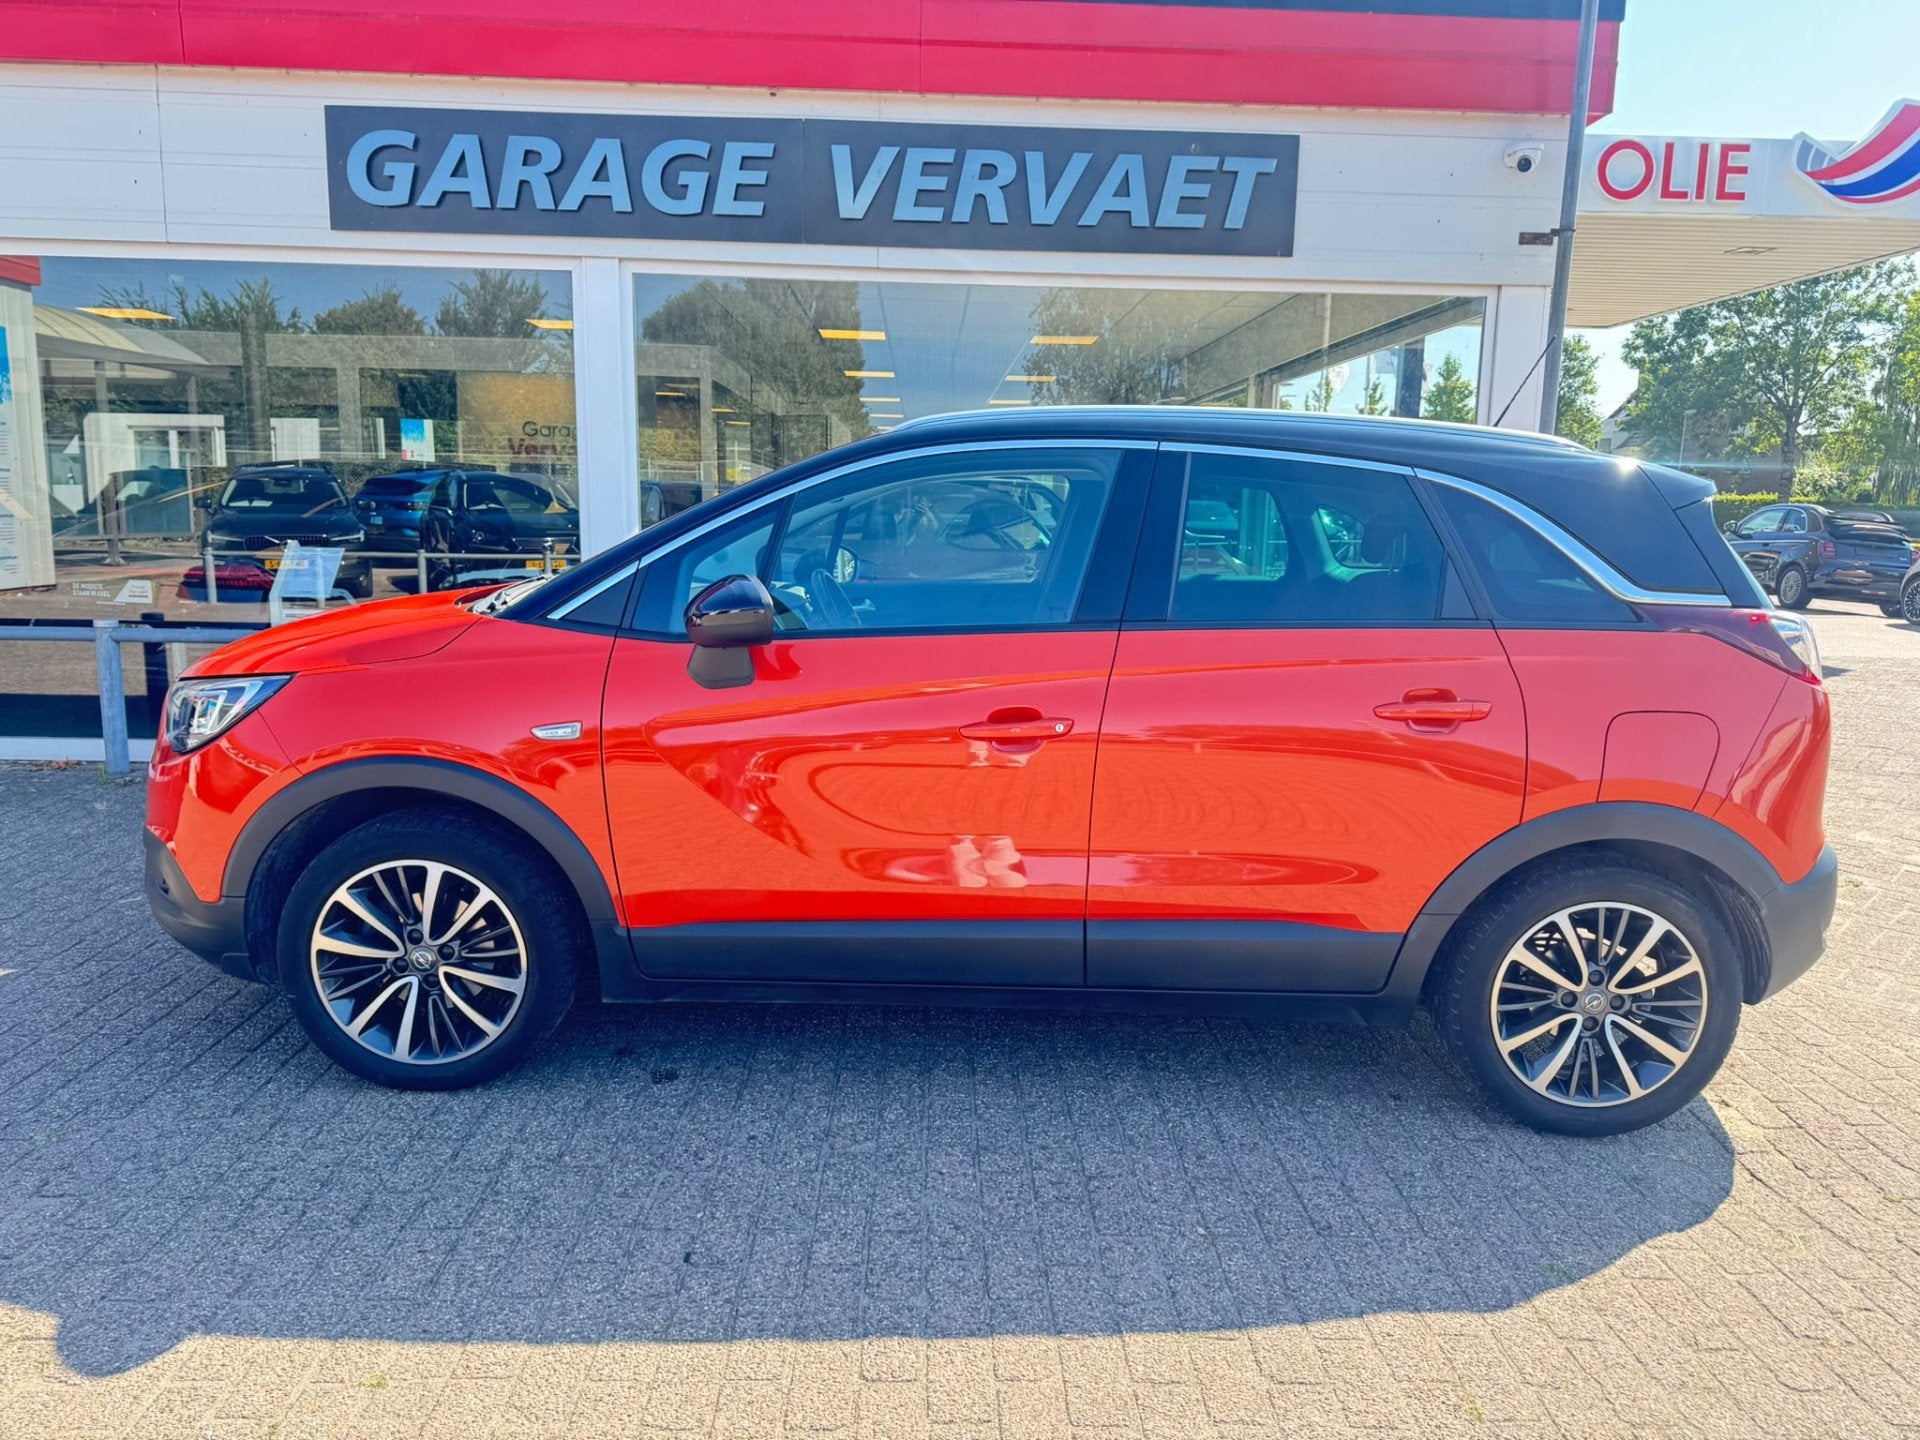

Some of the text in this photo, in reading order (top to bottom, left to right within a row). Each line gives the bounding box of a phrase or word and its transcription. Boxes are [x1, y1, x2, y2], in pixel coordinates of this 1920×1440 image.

[346, 129, 1278, 230] GARAGE VERVAET
[1597, 139, 1751, 202] OLIE
